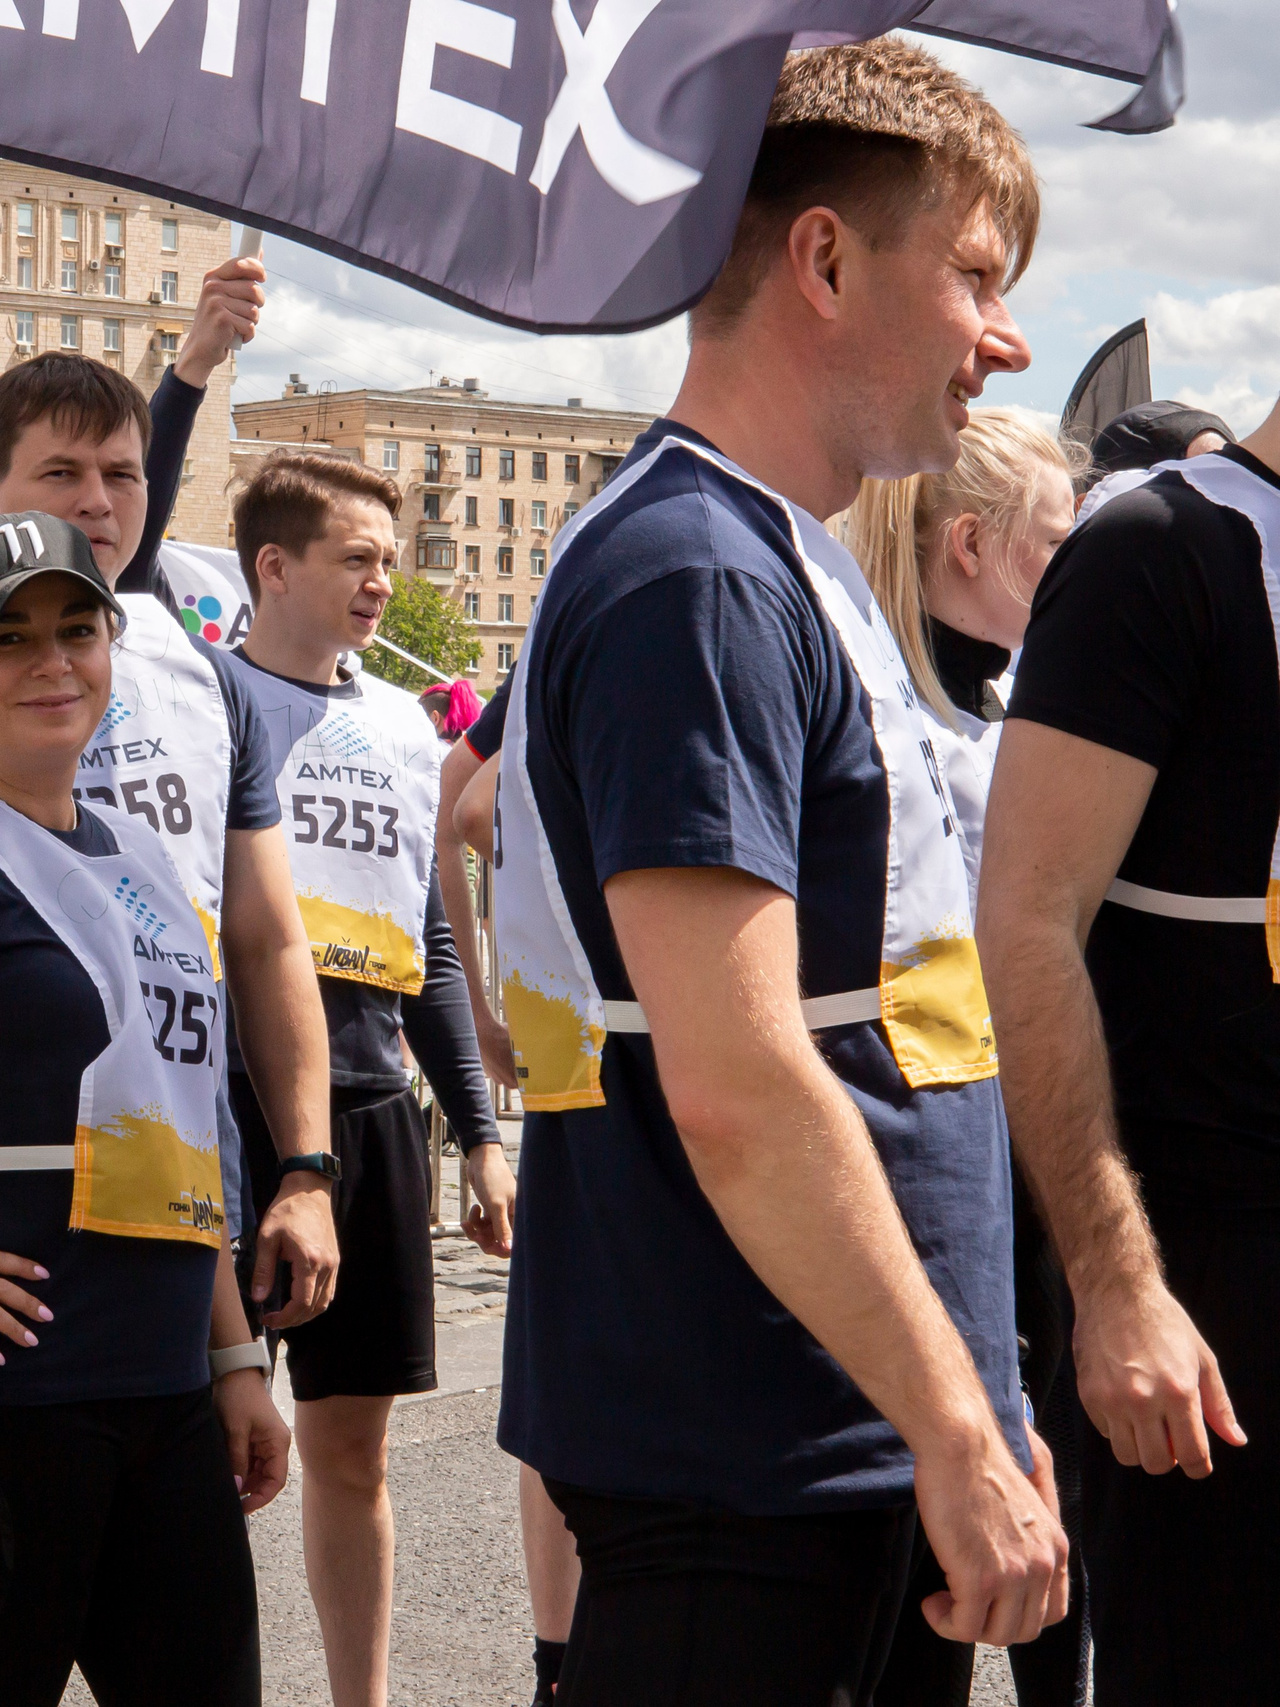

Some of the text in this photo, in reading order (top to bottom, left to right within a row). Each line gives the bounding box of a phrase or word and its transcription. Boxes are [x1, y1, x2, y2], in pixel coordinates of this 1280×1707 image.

[78, 737, 169, 770] MTEX
[296, 762, 394, 792] AMTEX
[72, 772, 193, 835] 58
[291, 794, 400, 859] 5253
[322, 942, 370, 973] URBAN
